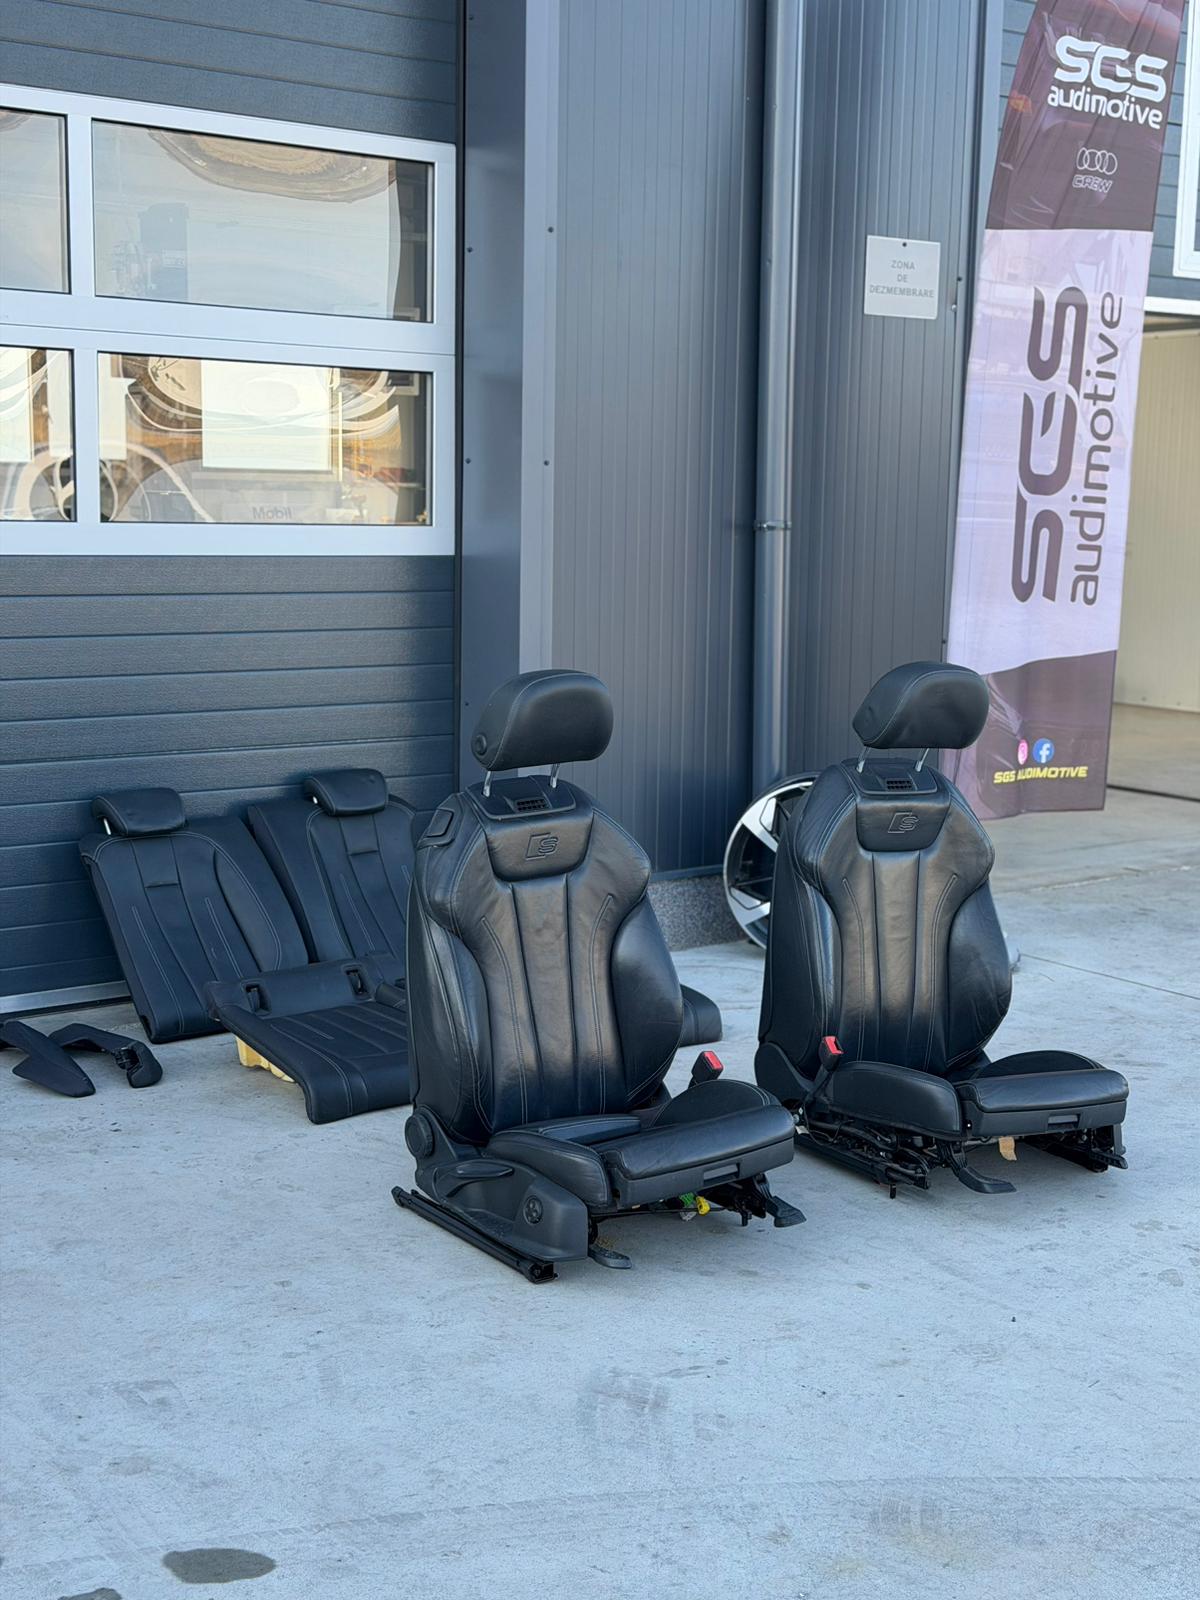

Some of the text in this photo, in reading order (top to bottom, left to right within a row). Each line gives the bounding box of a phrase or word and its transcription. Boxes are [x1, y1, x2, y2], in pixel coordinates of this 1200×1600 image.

[1054, 35, 1168, 102] SGS
[1047, 85, 1163, 130] audimotive
[1072, 174, 1113, 193] CREW
[890, 259, 915, 270] ZONA
[896, 273, 909, 283] DE
[869, 284, 935, 298] DEZMEMBRARE
[1011, 286, 1088, 603] SGS
[1069, 291, 1123, 606] audimotive
[993, 770, 1016, 784] SGS
